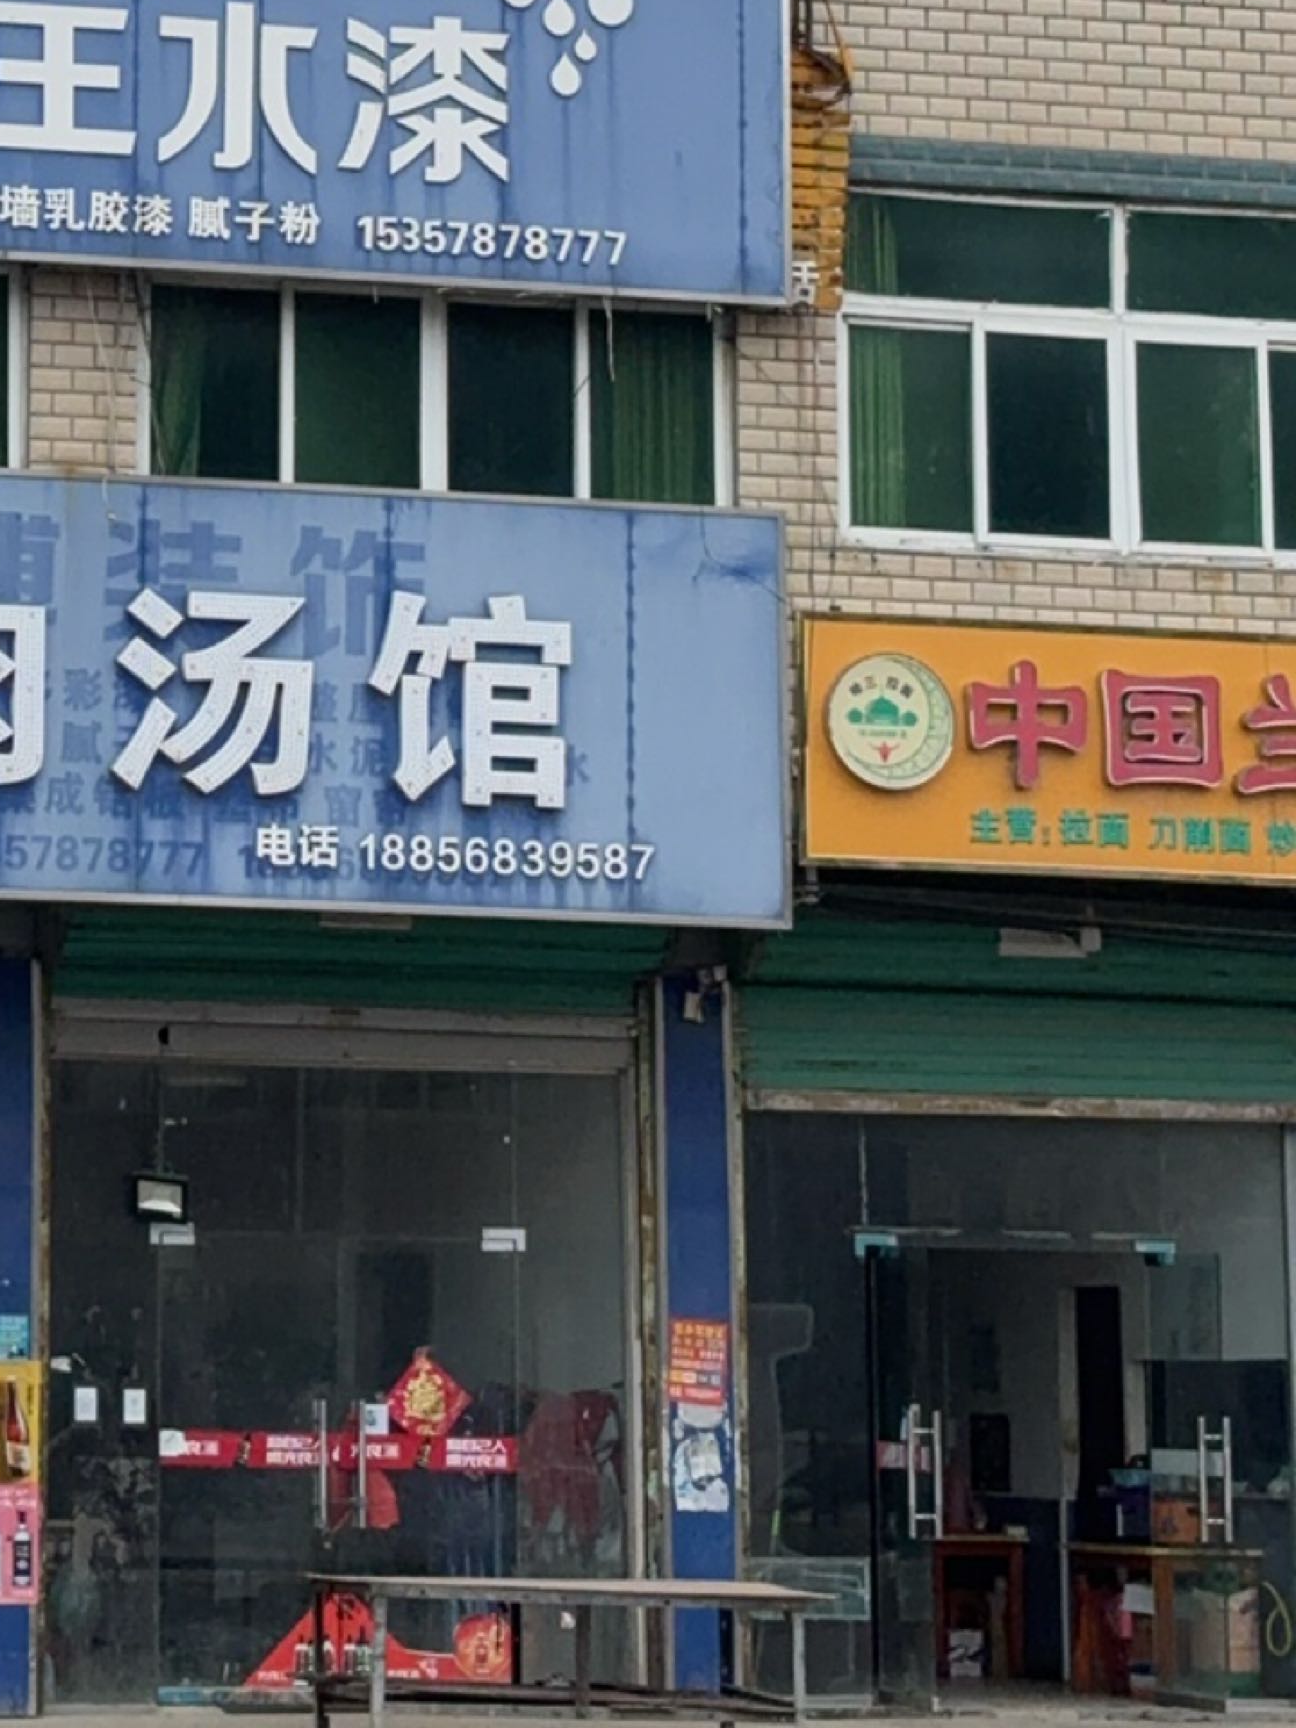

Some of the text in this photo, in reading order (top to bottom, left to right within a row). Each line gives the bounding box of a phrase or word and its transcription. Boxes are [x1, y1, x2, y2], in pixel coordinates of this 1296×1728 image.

[188, 196, 321, 246] 腻子粉
[357, 214, 626, 267] 15357878777
[256, 823, 340, 868] 电话
[359, 833, 657, 881] 18856839587
